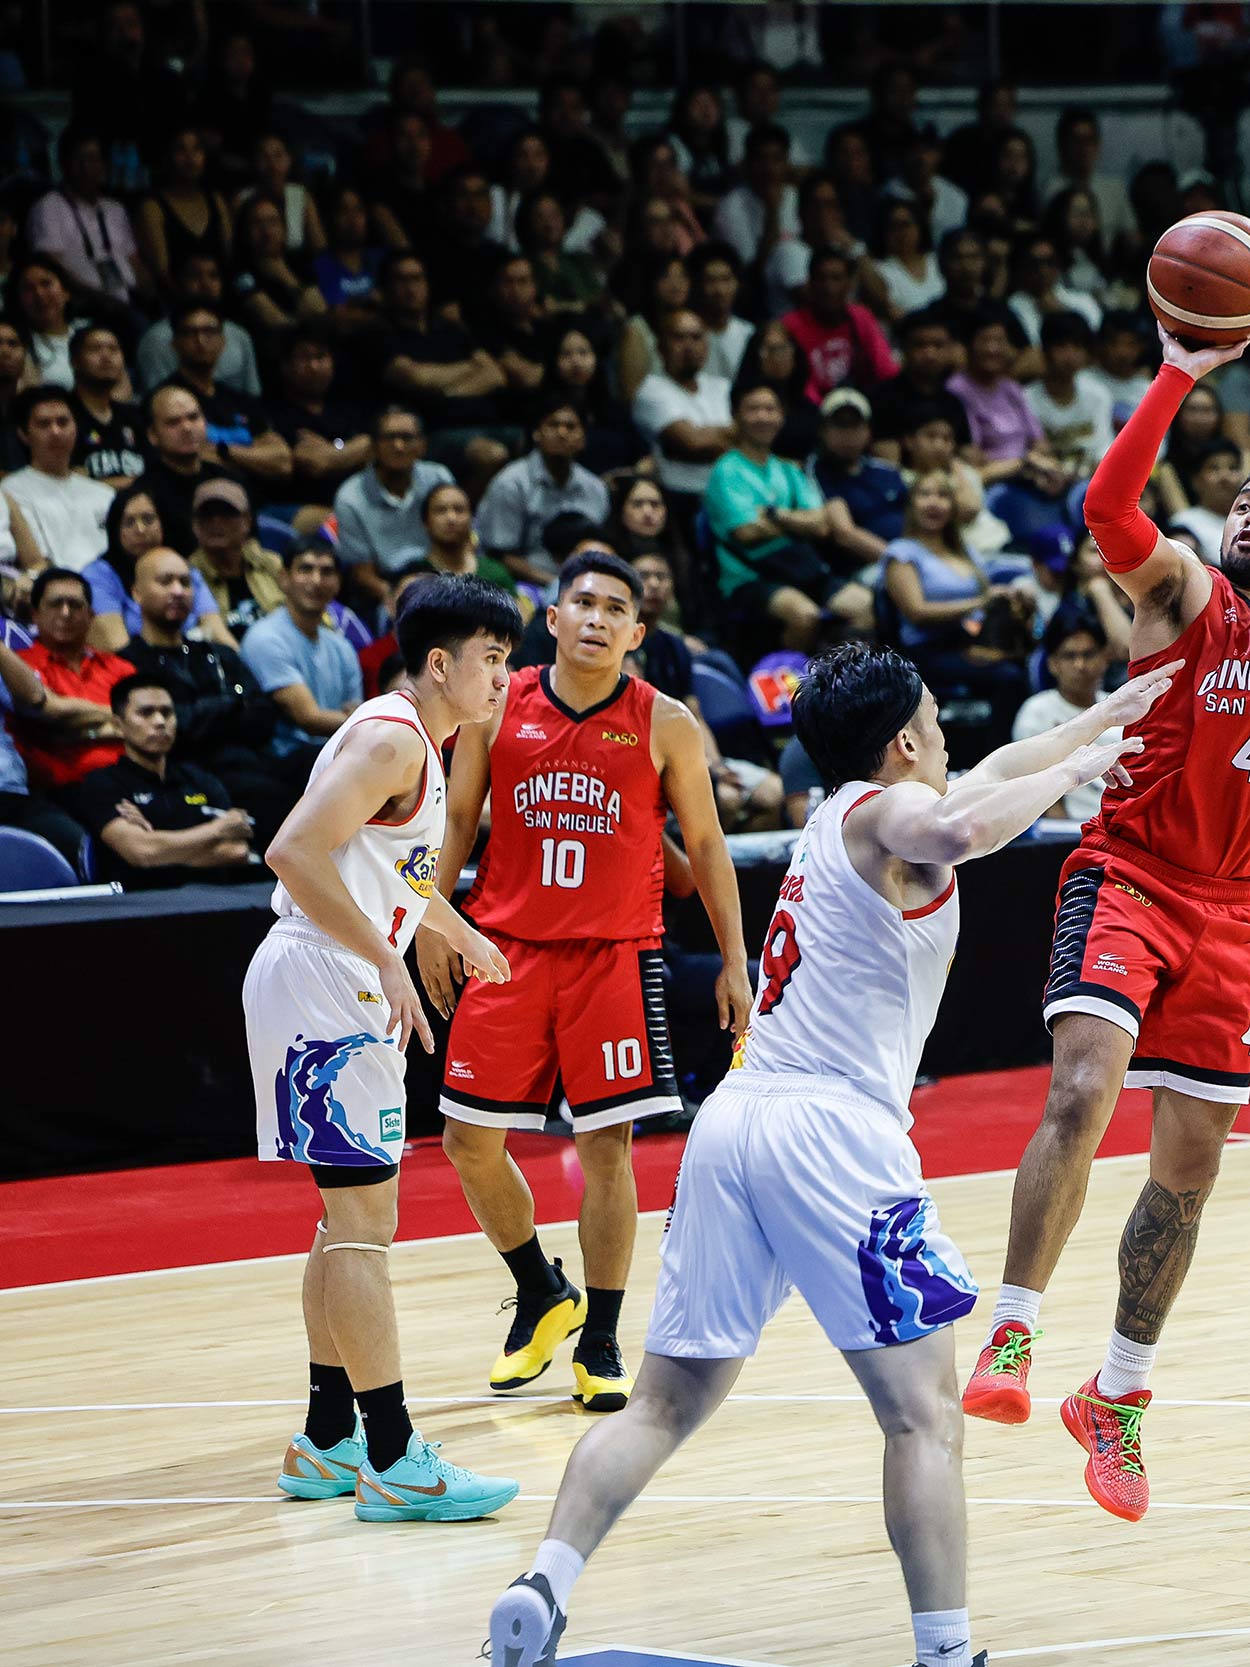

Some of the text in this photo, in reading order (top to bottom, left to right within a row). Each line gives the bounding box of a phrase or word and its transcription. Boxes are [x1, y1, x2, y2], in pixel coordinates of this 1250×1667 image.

[1205, 693, 1246, 716] SAN
[513, 771, 621, 824] GINEBRA
[524, 810, 615, 835] SAN MIGUEL
[401, 845, 437, 882] Rai
[541, 838, 586, 889] 10
[387, 906, 407, 949] 1
[757, 909, 802, 1016] 9
[1097, 960, 1126, 970] WORLD
[601, 1037, 642, 1081] 10
